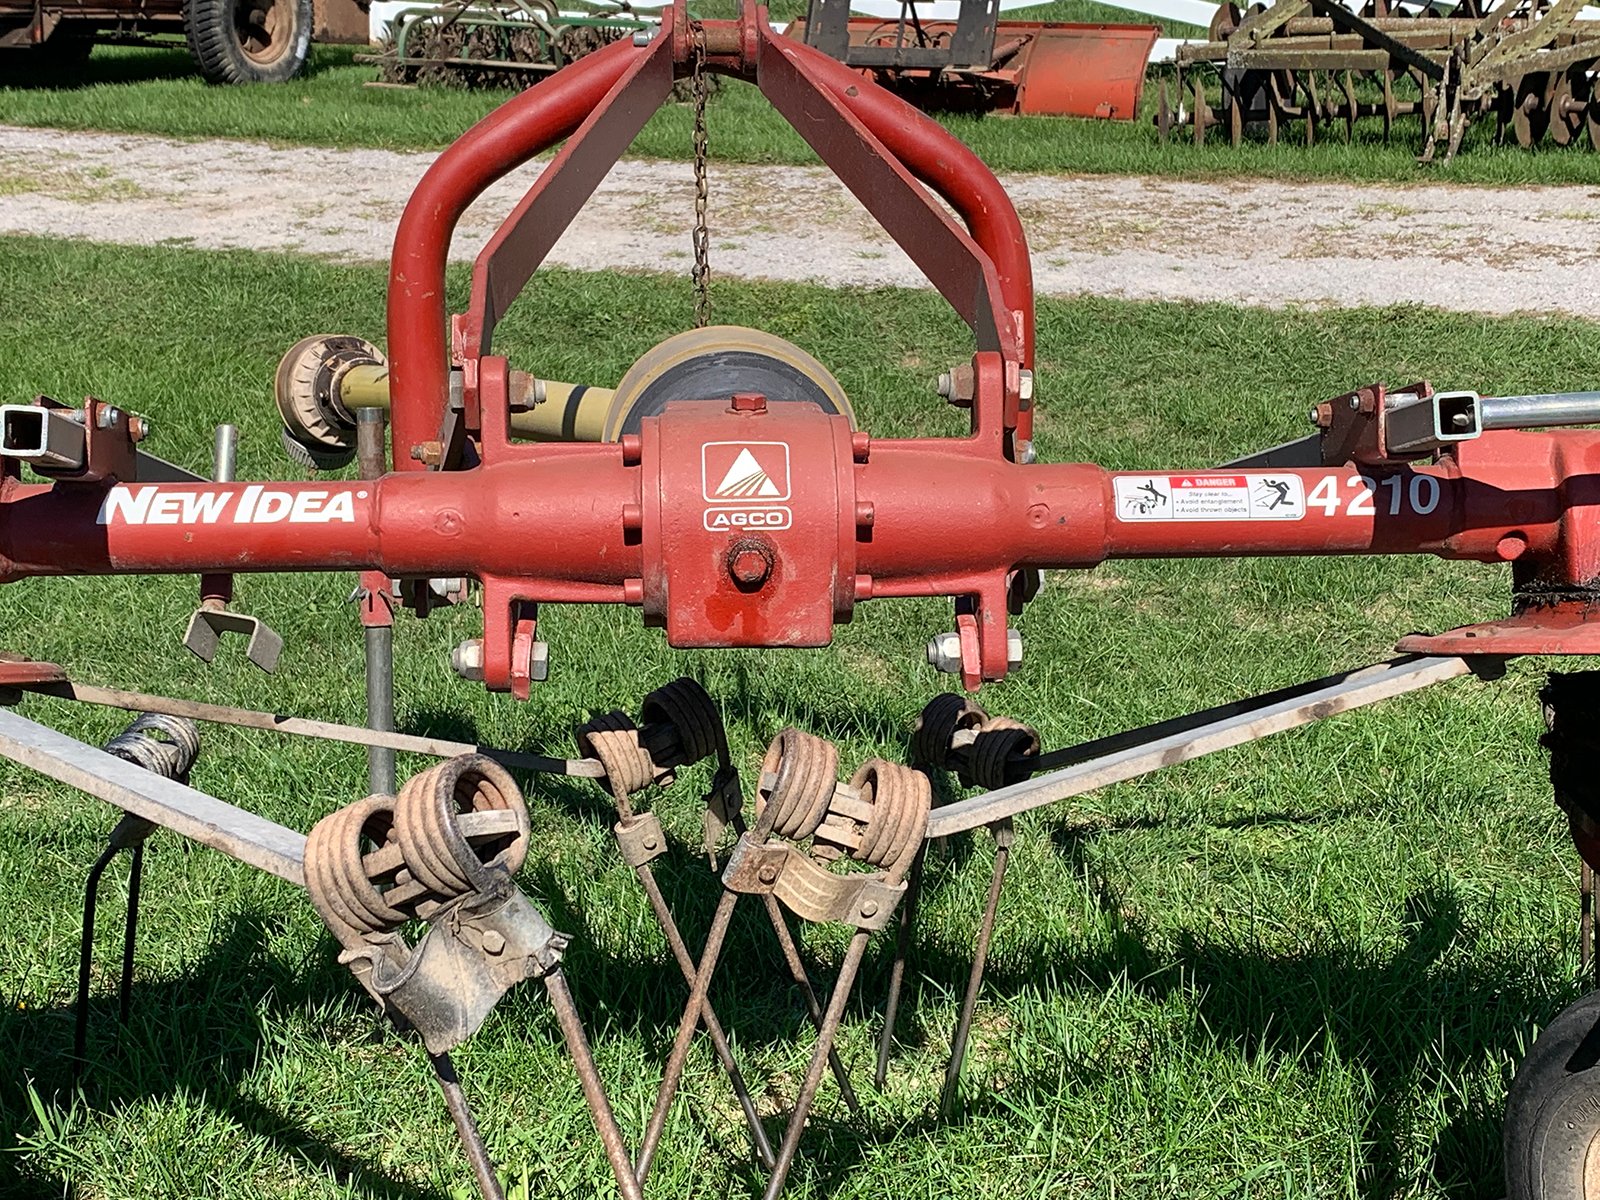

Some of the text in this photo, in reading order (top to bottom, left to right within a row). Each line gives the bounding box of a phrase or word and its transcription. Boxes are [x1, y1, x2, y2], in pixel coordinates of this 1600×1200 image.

[1194, 478, 1236, 487] DANGER
[1200, 498, 1243, 506] entanglement
[1306, 474, 1441, 517] 4210
[96, 486, 234, 525] NEW
[712, 511, 784, 526] AGCO
